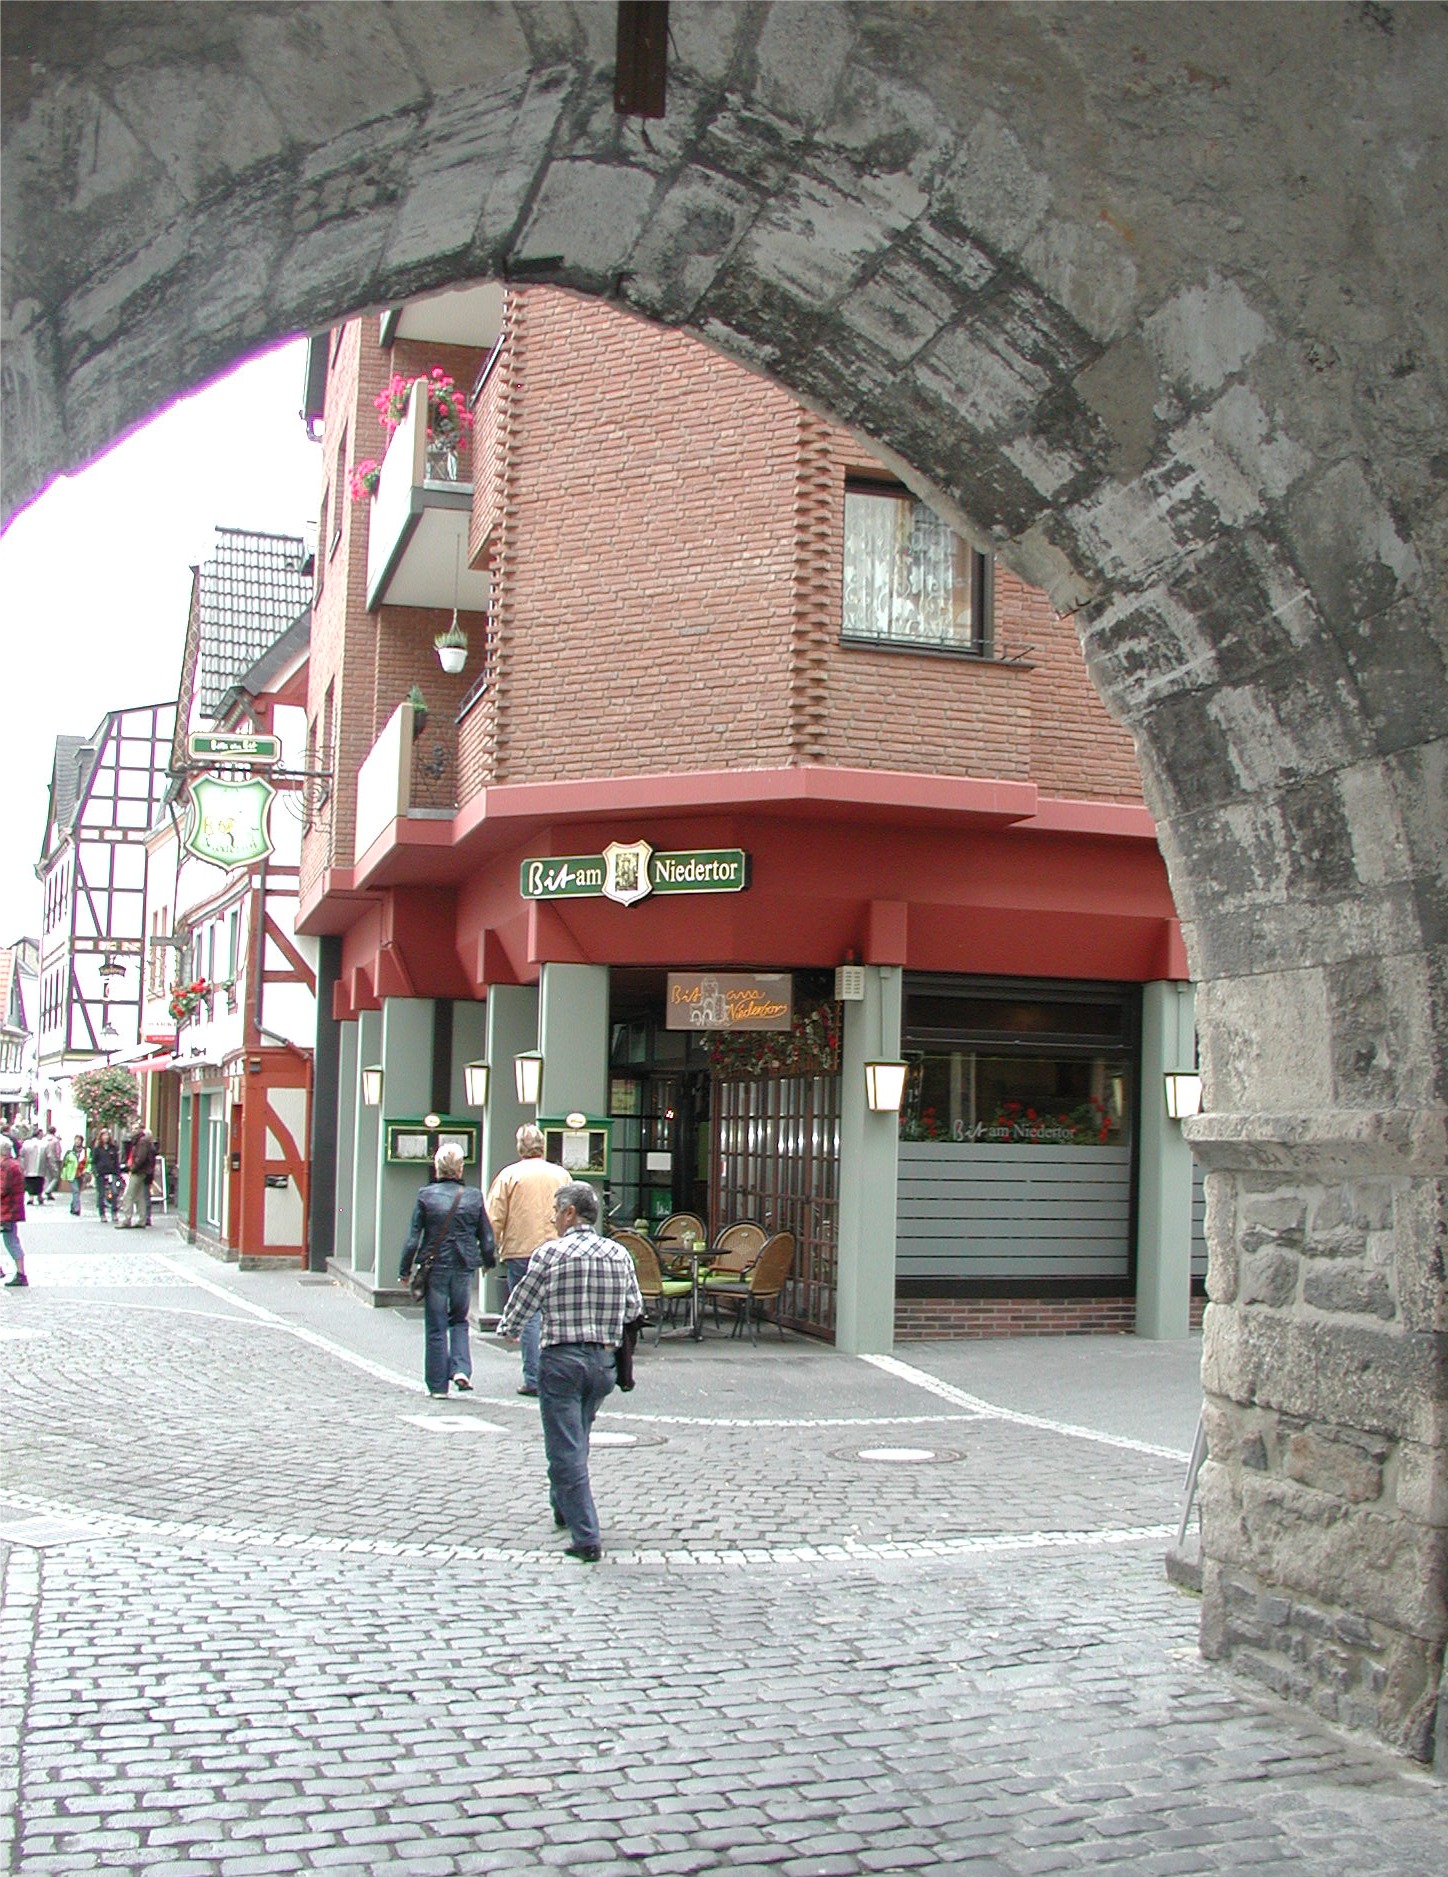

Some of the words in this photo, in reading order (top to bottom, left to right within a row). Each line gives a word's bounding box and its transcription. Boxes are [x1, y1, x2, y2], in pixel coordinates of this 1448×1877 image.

[528, 861, 576, 895] Bit
[576, 869, 602, 886] am
[655, 859, 738, 883] Niedertor
[729, 999, 788, 1021] Niedertor
[989, 1126, 1009, 1138] am
[1013, 1123, 1076, 1139] Niedertor
